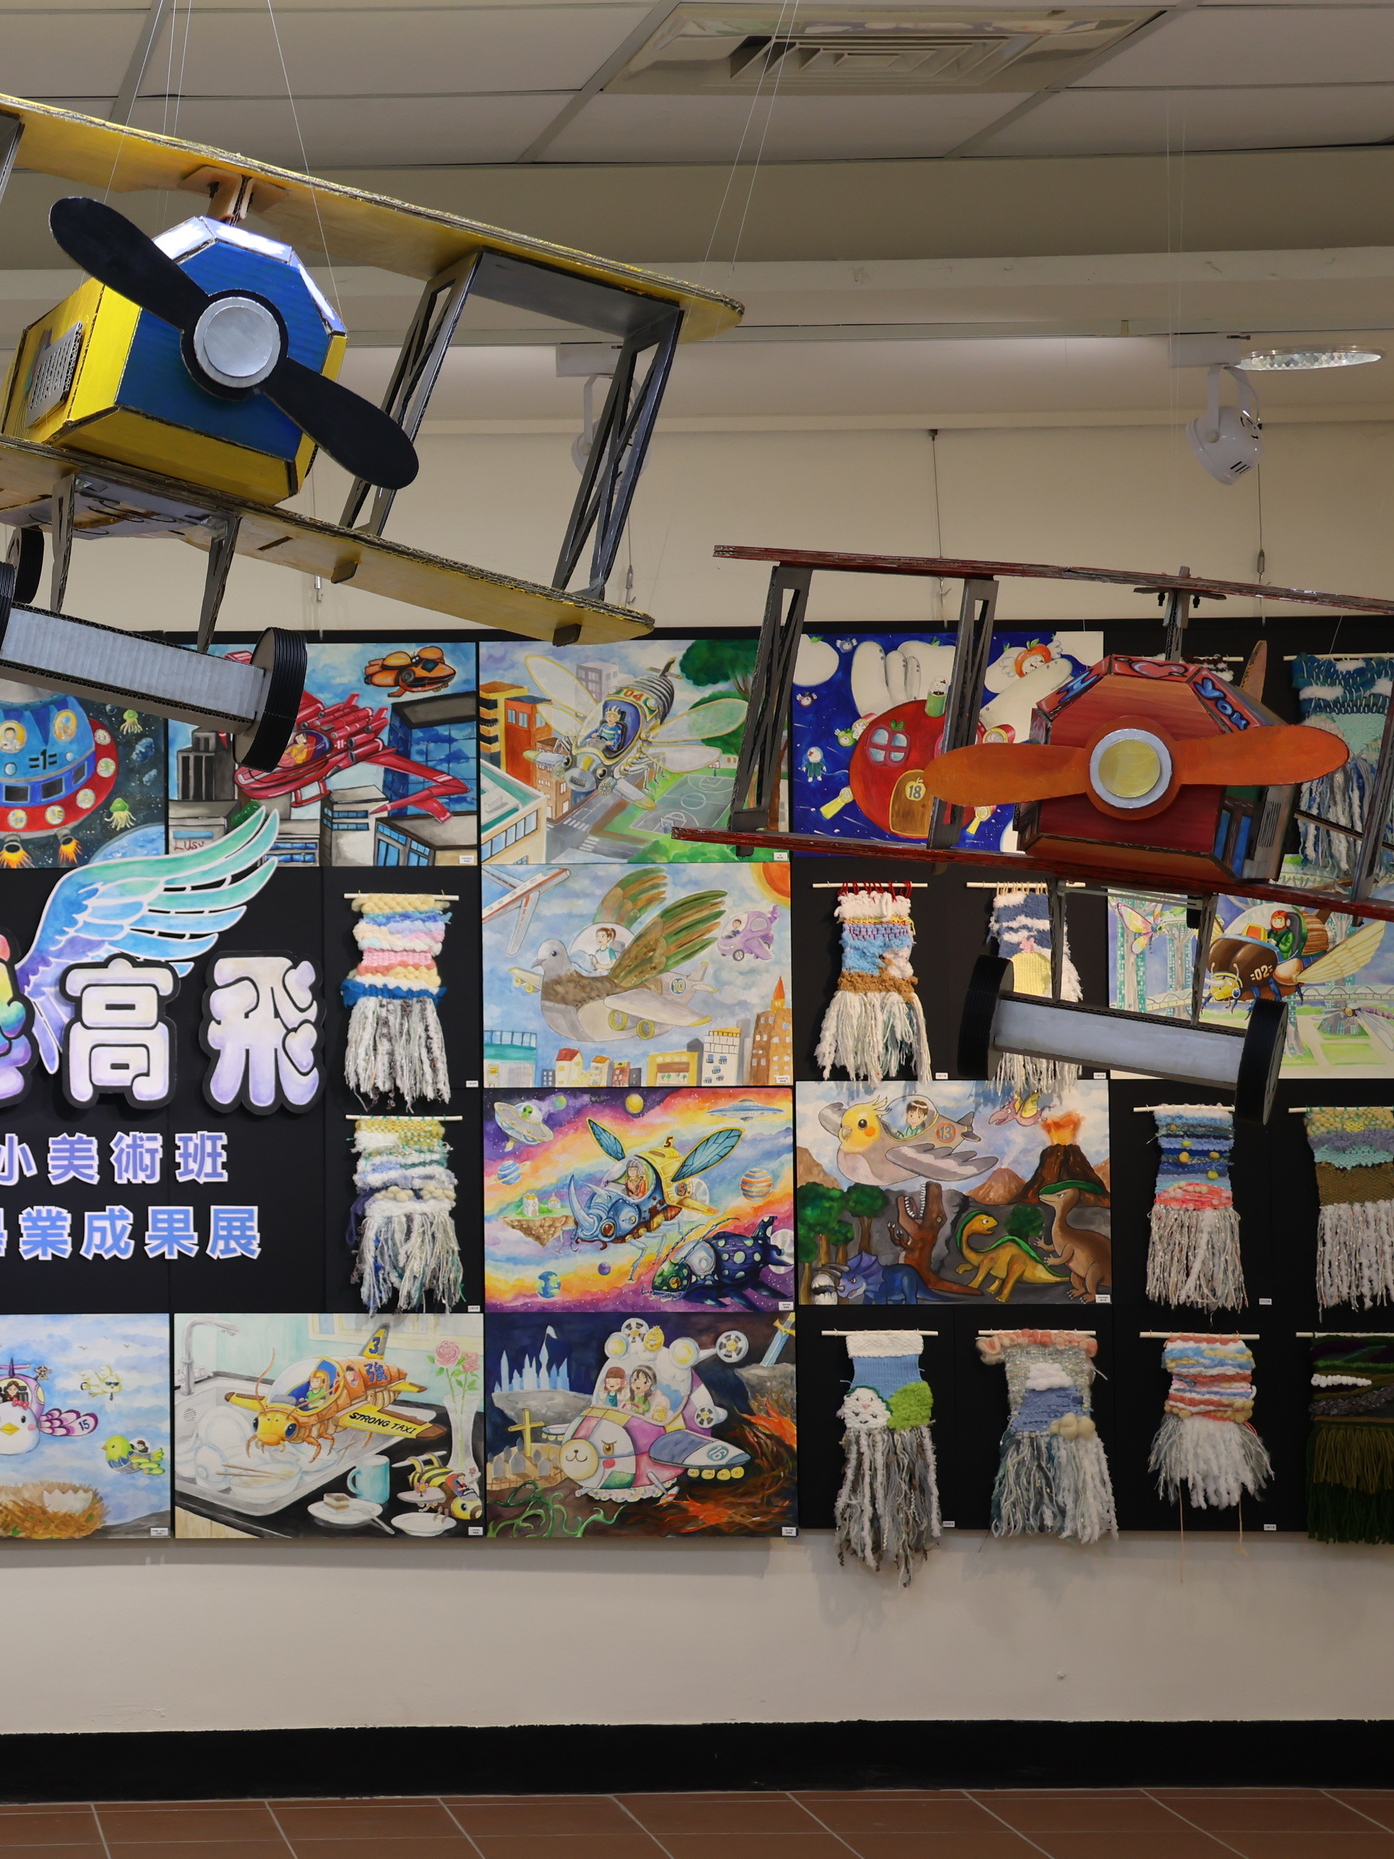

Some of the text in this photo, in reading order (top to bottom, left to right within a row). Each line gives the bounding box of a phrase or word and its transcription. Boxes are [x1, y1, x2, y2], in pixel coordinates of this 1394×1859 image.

[623, 689, 644, 702] 04
[908, 784, 922, 799] 18
[672, 979, 686, 993] 10
[939, 1125, 953, 1141] 13
[663, 1135, 674, 1148] 5
[676, 1183, 686, 1196] 5
[368, 1336, 381, 1354] 3
[364, 1361, 388, 1382] 強
[78, 1418, 90, 1431] 15
[349, 1412, 418, 1434] STRONG TAXI
[708, 1445, 728, 1460] 16
